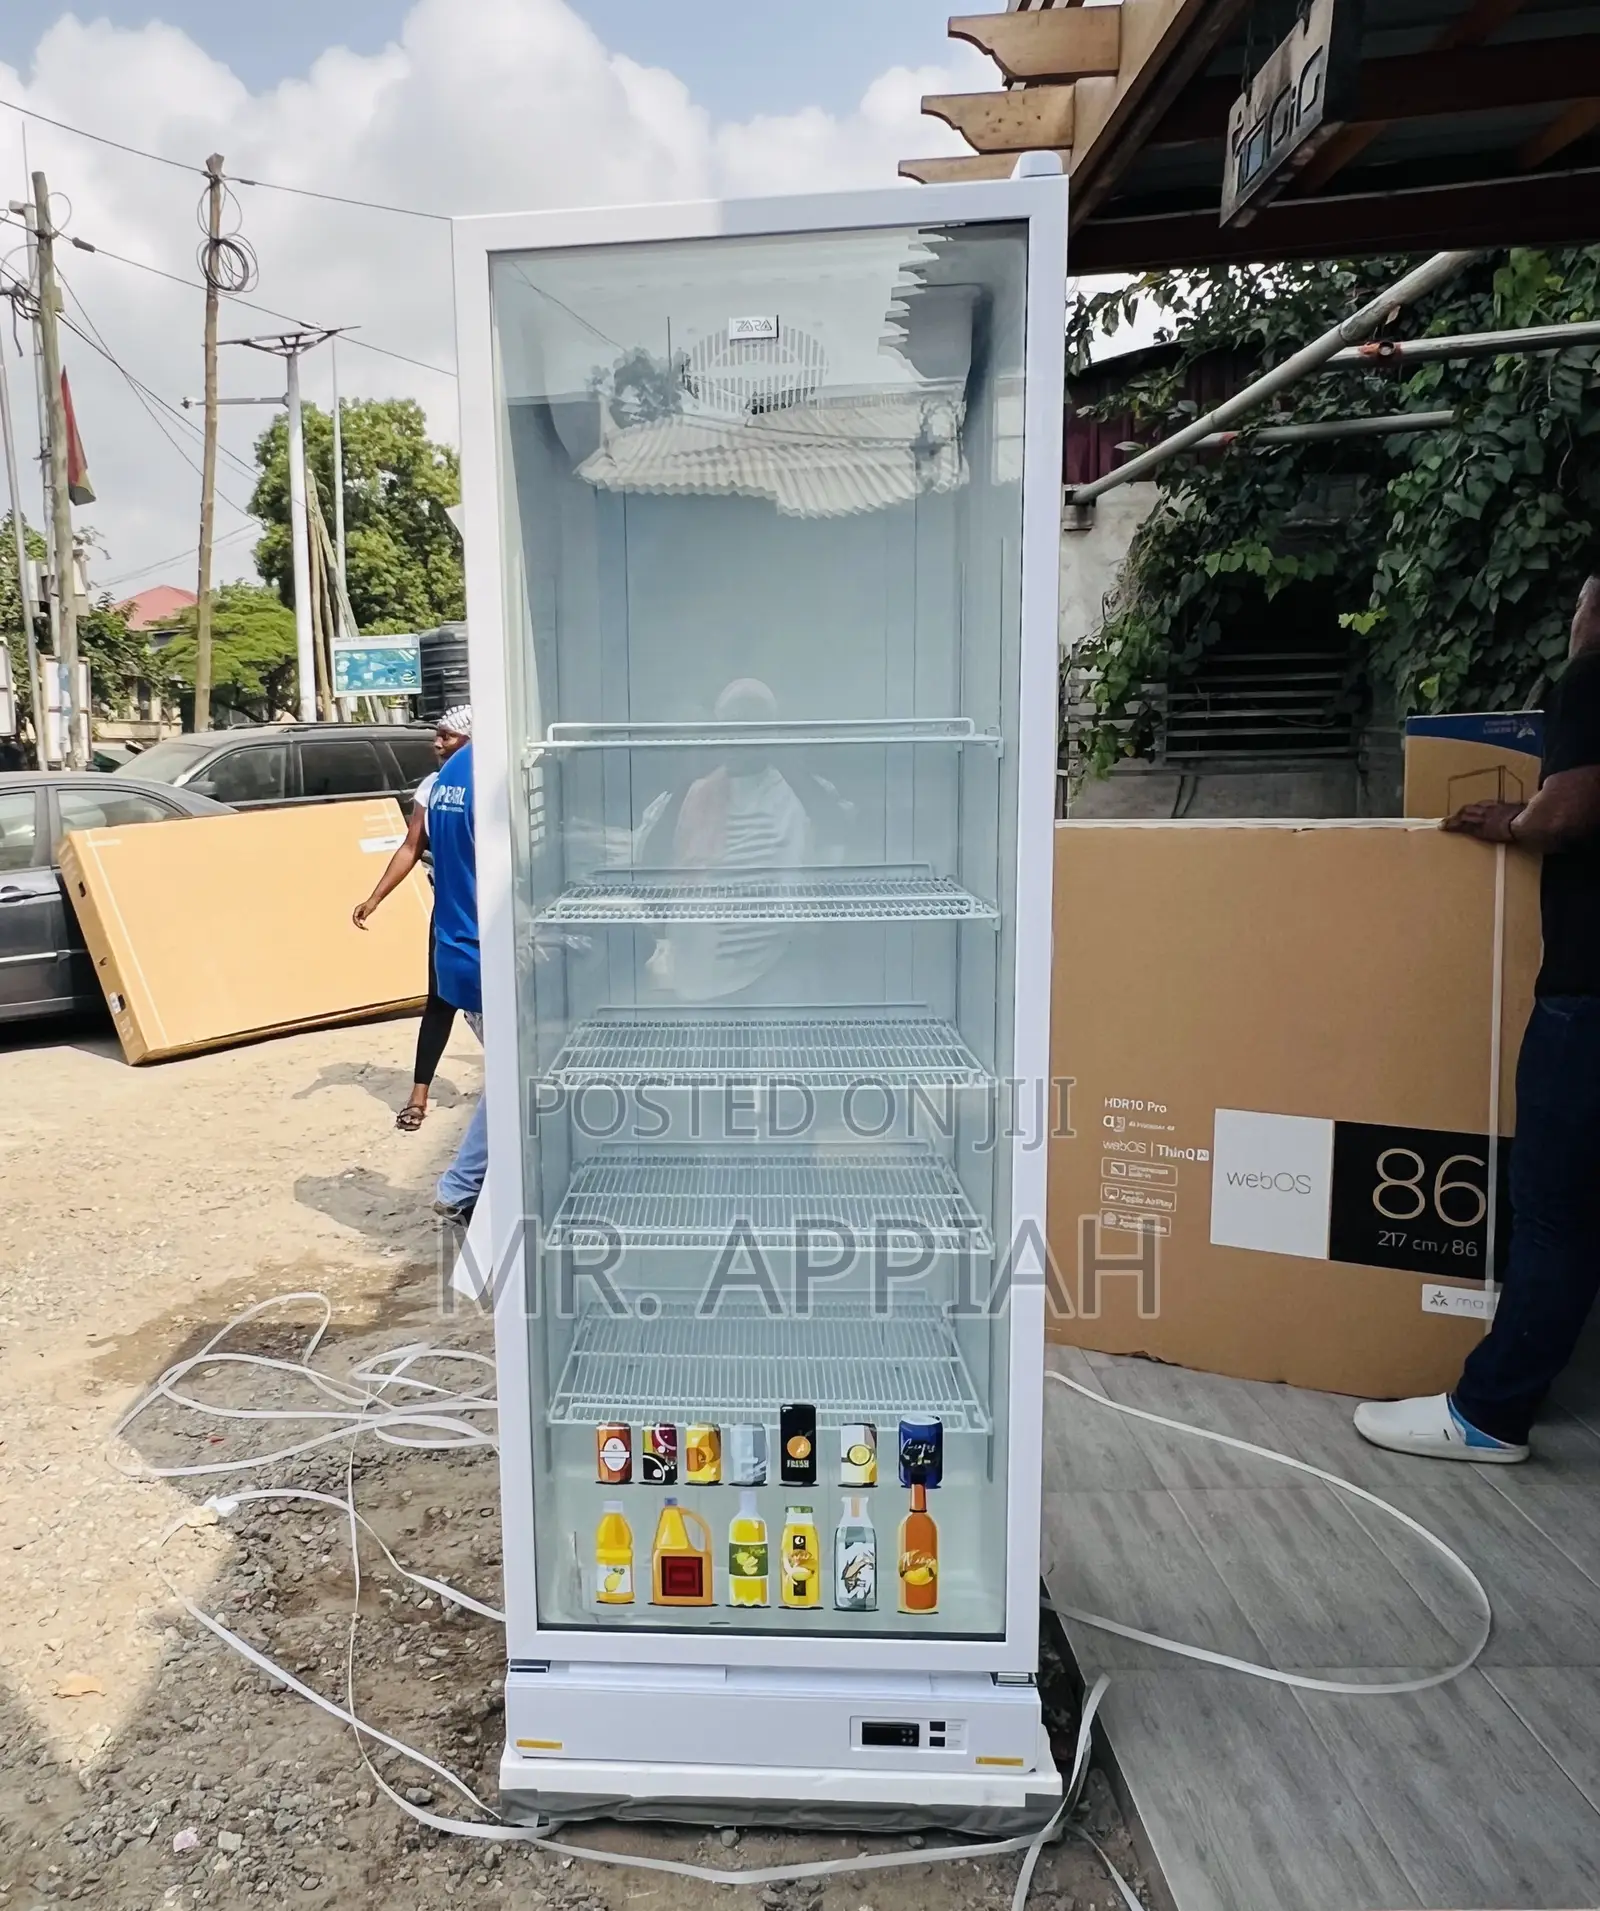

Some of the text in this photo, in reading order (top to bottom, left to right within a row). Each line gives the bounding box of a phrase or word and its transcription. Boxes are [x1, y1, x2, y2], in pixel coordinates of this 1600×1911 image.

[736, 319, 773, 333] ZARA
[1104, 1097, 1167, 1113] HDR10 Pro
[1102, 1140, 1147, 1154] webOS
[1156, 1144, 1195, 1161] ThinQ
[1226, 1172, 1312, 1195] webOS
[1372, 1148, 1487, 1227] 86
[1377, 1230, 1407, 1248] 217
[1412, 1239, 1438, 1253] cm
[1451, 1239, 1478, 1257] 86
